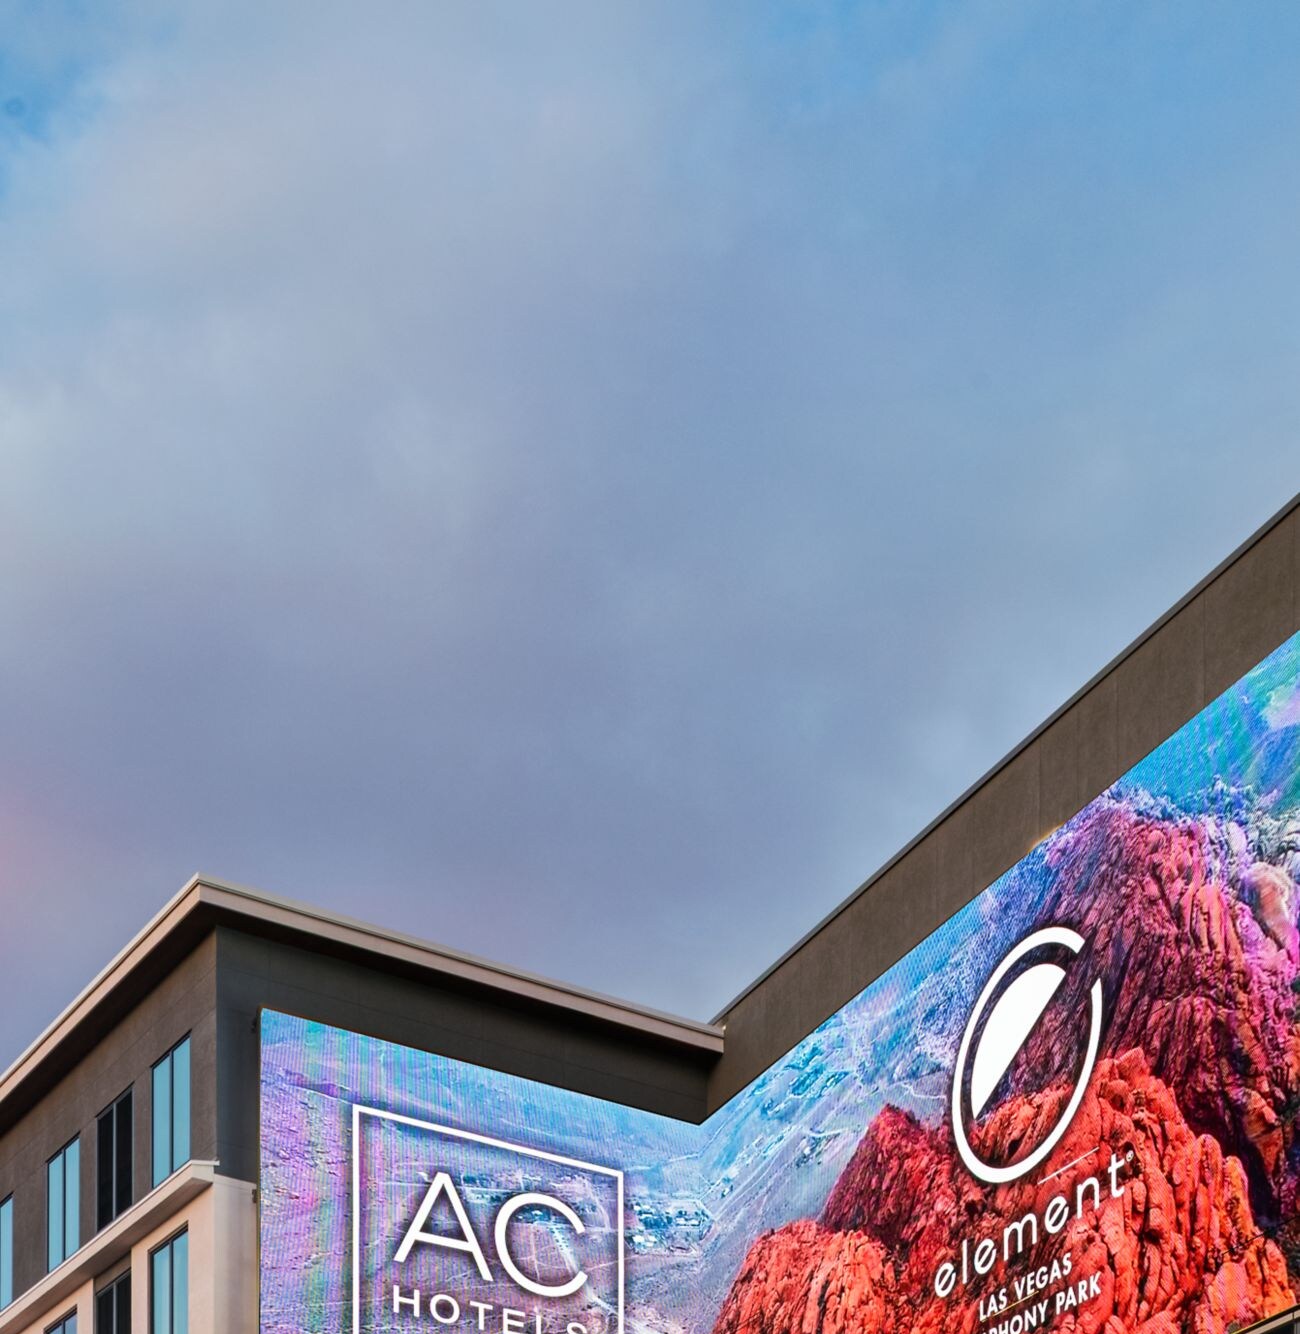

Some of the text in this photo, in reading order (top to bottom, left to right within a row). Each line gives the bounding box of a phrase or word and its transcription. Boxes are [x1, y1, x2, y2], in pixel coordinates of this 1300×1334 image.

[394, 1171, 588, 1298] AC
[979, 1252, 1073, 1322] LAS VEGAS
[1055, 1271, 1102, 1315] PARK
